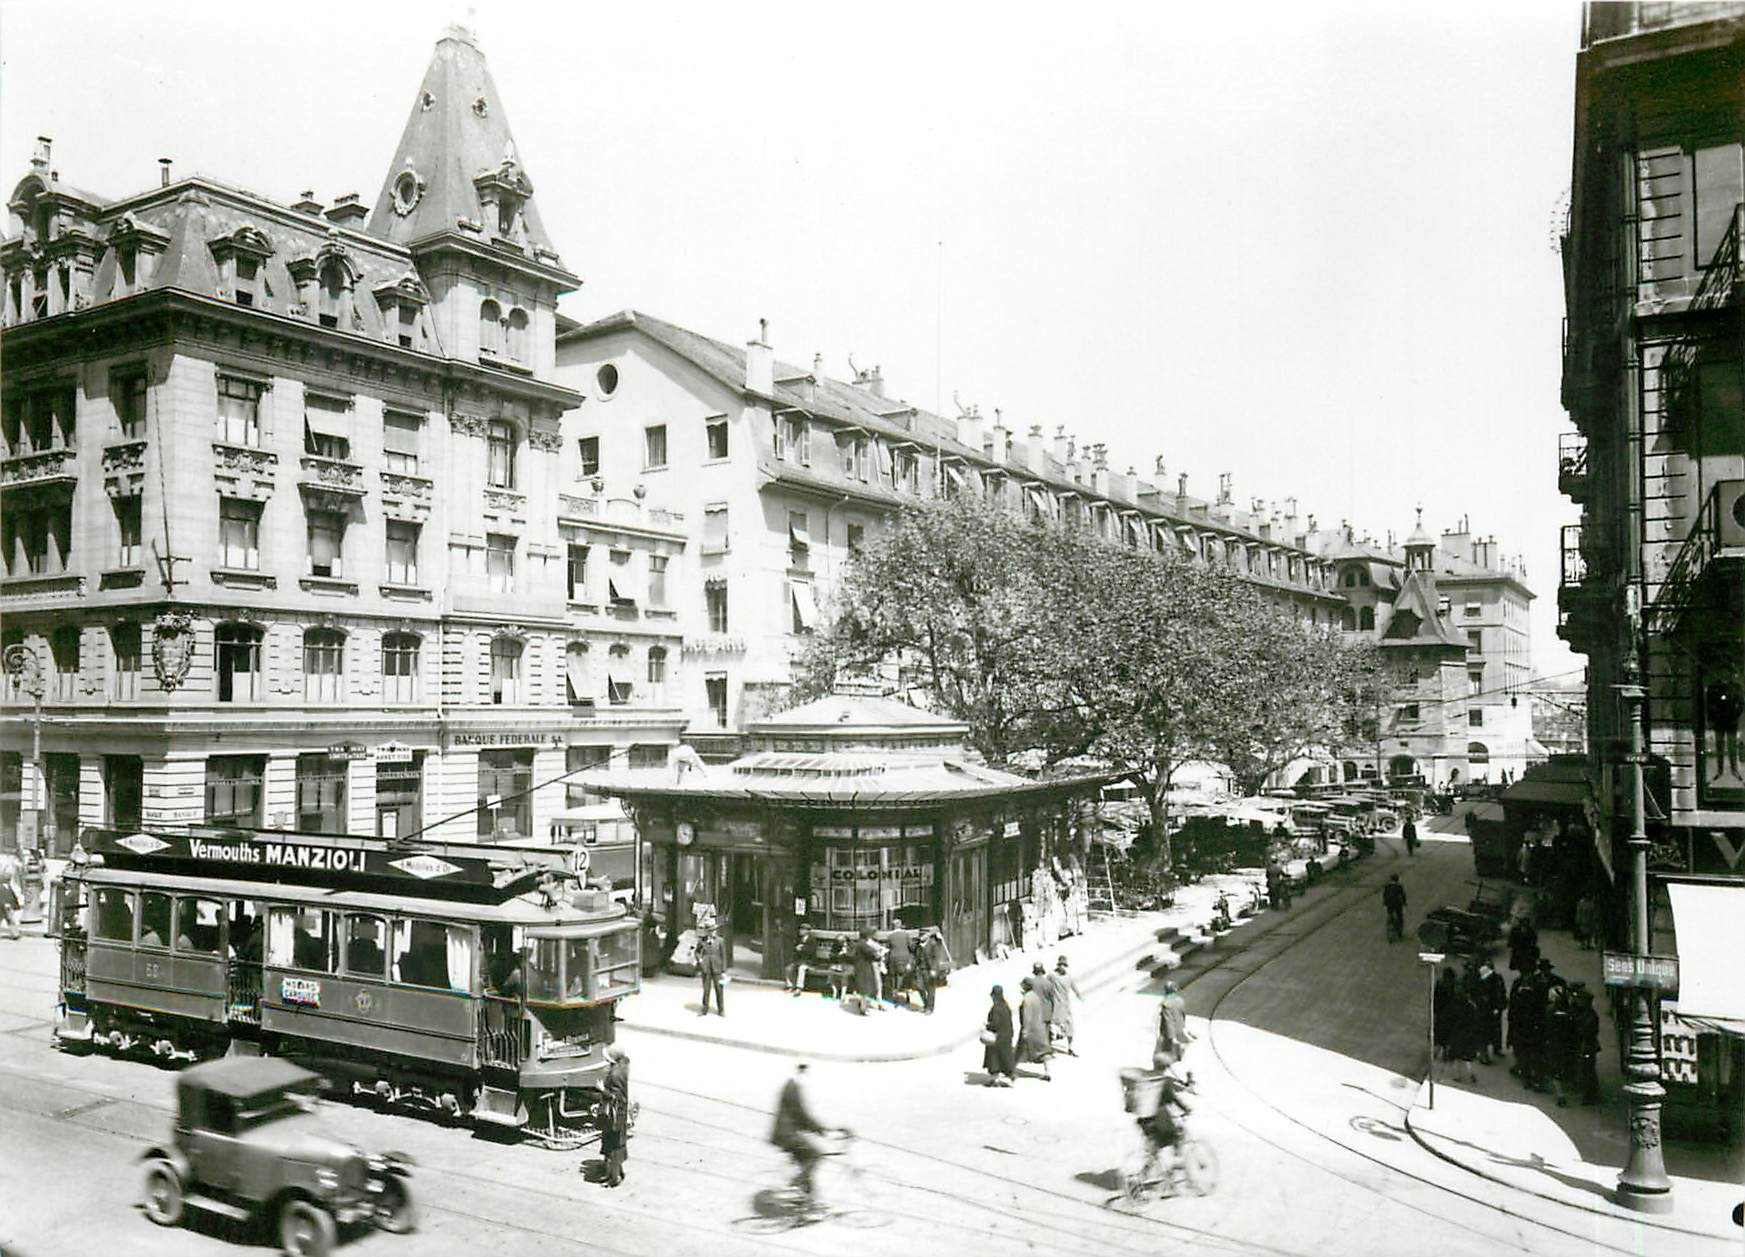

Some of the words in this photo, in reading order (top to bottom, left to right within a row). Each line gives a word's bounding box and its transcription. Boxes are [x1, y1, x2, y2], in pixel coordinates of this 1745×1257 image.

[454, 735, 496, 746] BANQUE
[499, 734, 546, 745] FEDERALE
[189, 839, 260, 863] Vermouths
[266, 844, 366, 873] MANZIOLI
[575, 851, 586, 871] 12
